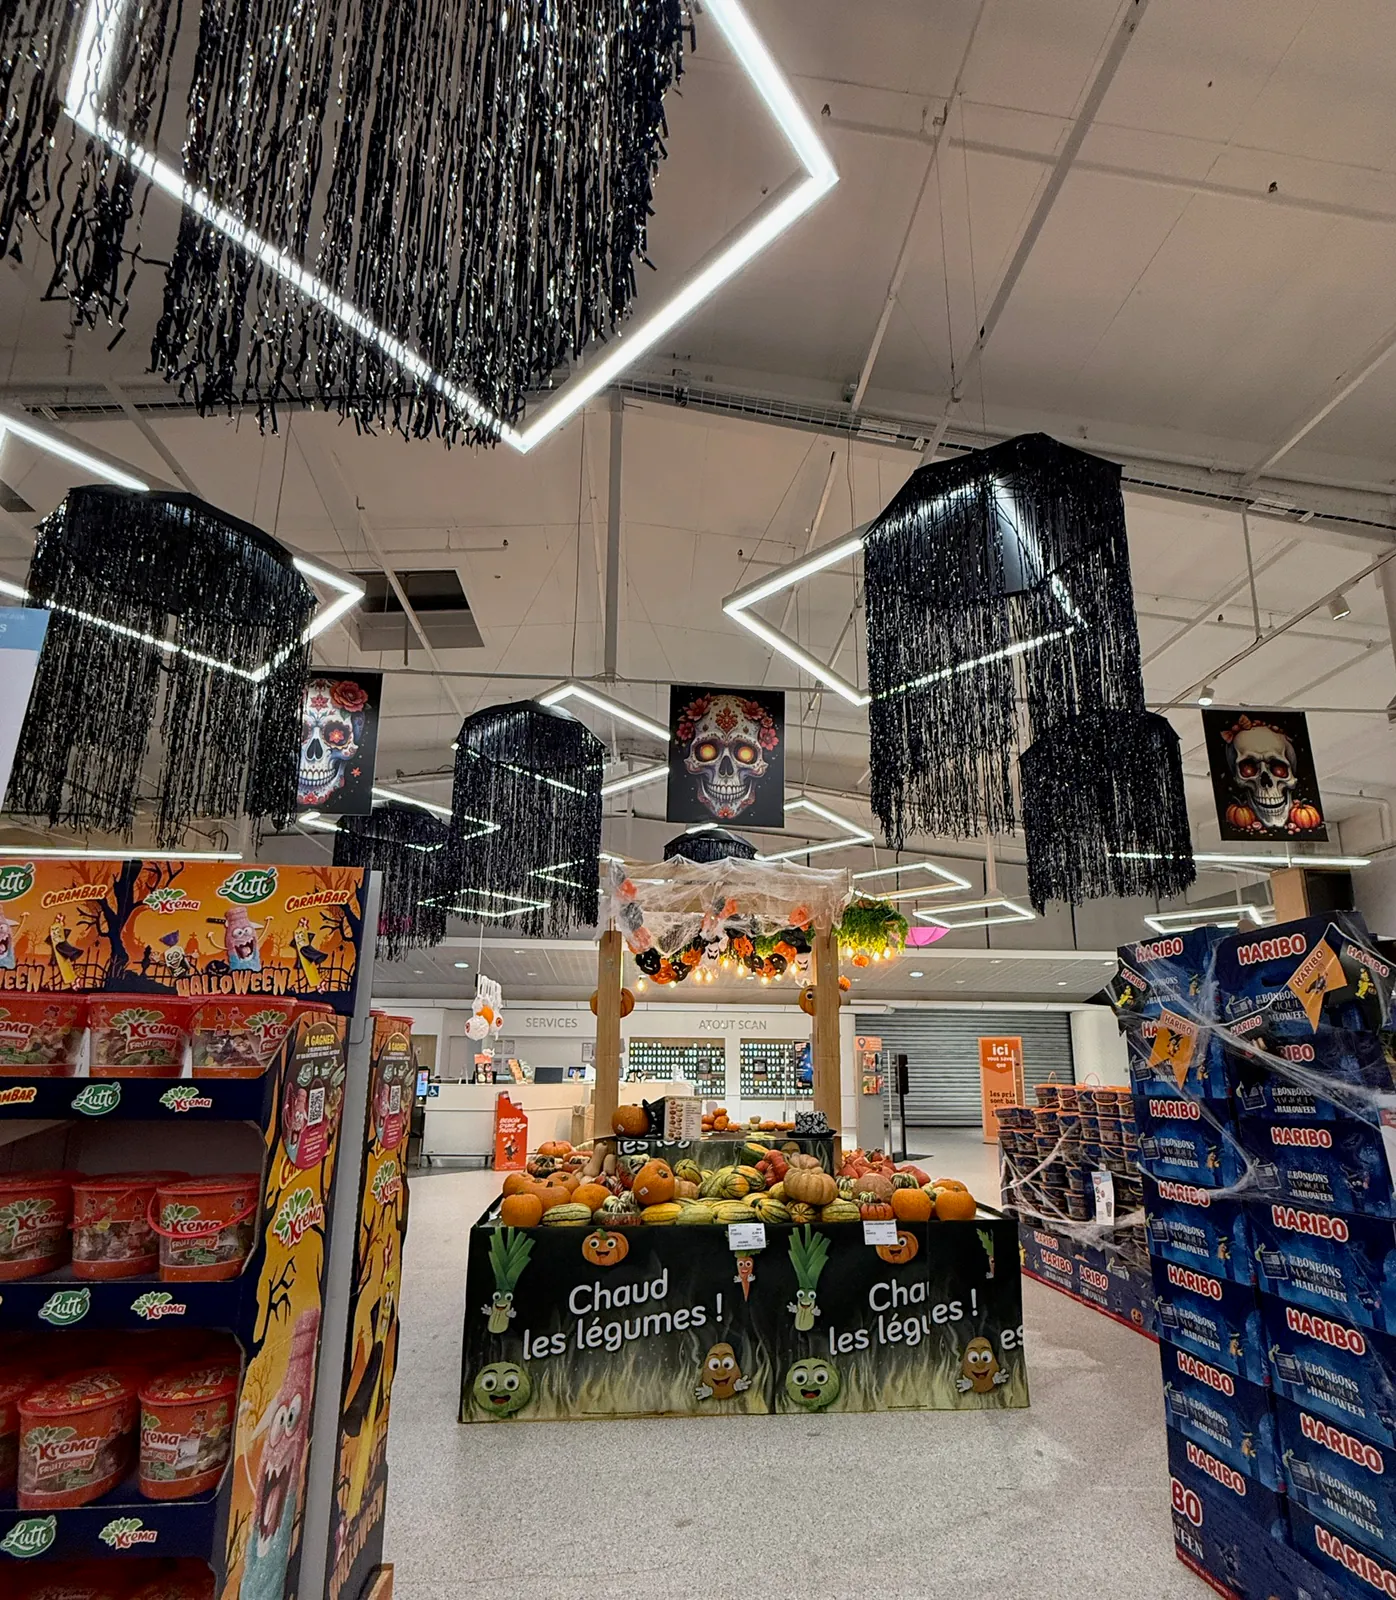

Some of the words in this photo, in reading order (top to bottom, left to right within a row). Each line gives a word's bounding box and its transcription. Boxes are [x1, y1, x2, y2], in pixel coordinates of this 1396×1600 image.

[43, 885, 107, 908] CARAMBAR
[218, 872, 270, 899] Lutti
[286, 890, 348, 911] CARAMBAR
[1136, 937, 1184, 963] HARIBO
[1238, 933, 1307, 966] HARIBO
[1347, 944, 1389, 977] HARIBO
[1121, 968, 1147, 991] HARIBO
[1293, 948, 1324, 988] HARIBO
[176, 969, 289, 996] HALLOWEEN
[1261, 990, 1298, 1003] BONBON
[526, 1017, 578, 1029] SERVICES
[738, 1020, 767, 1030] SCAN
[1164, 1014, 1193, 1036] HARIBO
[1231, 1015, 1263, 1036] HARIBO
[992, 1043, 1009, 1056] ici
[74, 1087, 115, 1109] Lutti
[990, 1090, 1000, 1098] les
[1149, 1099, 1200, 1120] HARIBO
[1271, 1126, 1332, 1148] HARIBO
[1157, 1180, 1210, 1208] HARIBO
[1271, 1204, 1348, 1243] HARIBO
[1033, 1230, 1059, 1251] HARIBO
[1040, 1248, 1073, 1275] HARIBO
[1298, 1256, 1342, 1278] BONBONS
[1079, 1264, 1108, 1291] ARIBO
[1167, 1263, 1222, 1301] HARIBO
[569, 1268, 668, 1315] Chaud
[869, 1279, 930, 1312] Cha
[41, 1294, 83, 1319] Lutti
[523, 1329, 566, 1360] les
[576, 1303, 706, 1351] légumes
[716, 1293, 723, 1322] !
[1286, 1307, 1366, 1356] HARIBO
[829, 1326, 869, 1355] les
[1177, 1351, 1234, 1397] HARIBO
[1311, 1363, 1359, 1393] BONBONS
[1300, 1412, 1384, 1475] HARIBO
[1186, 1441, 1247, 1496] HARIBO
[1327, 1474, 1378, 1512] BONBONS
[2, 1521, 48, 1550] Lutti
[1315, 1524, 1396, 1600] HARIBO
